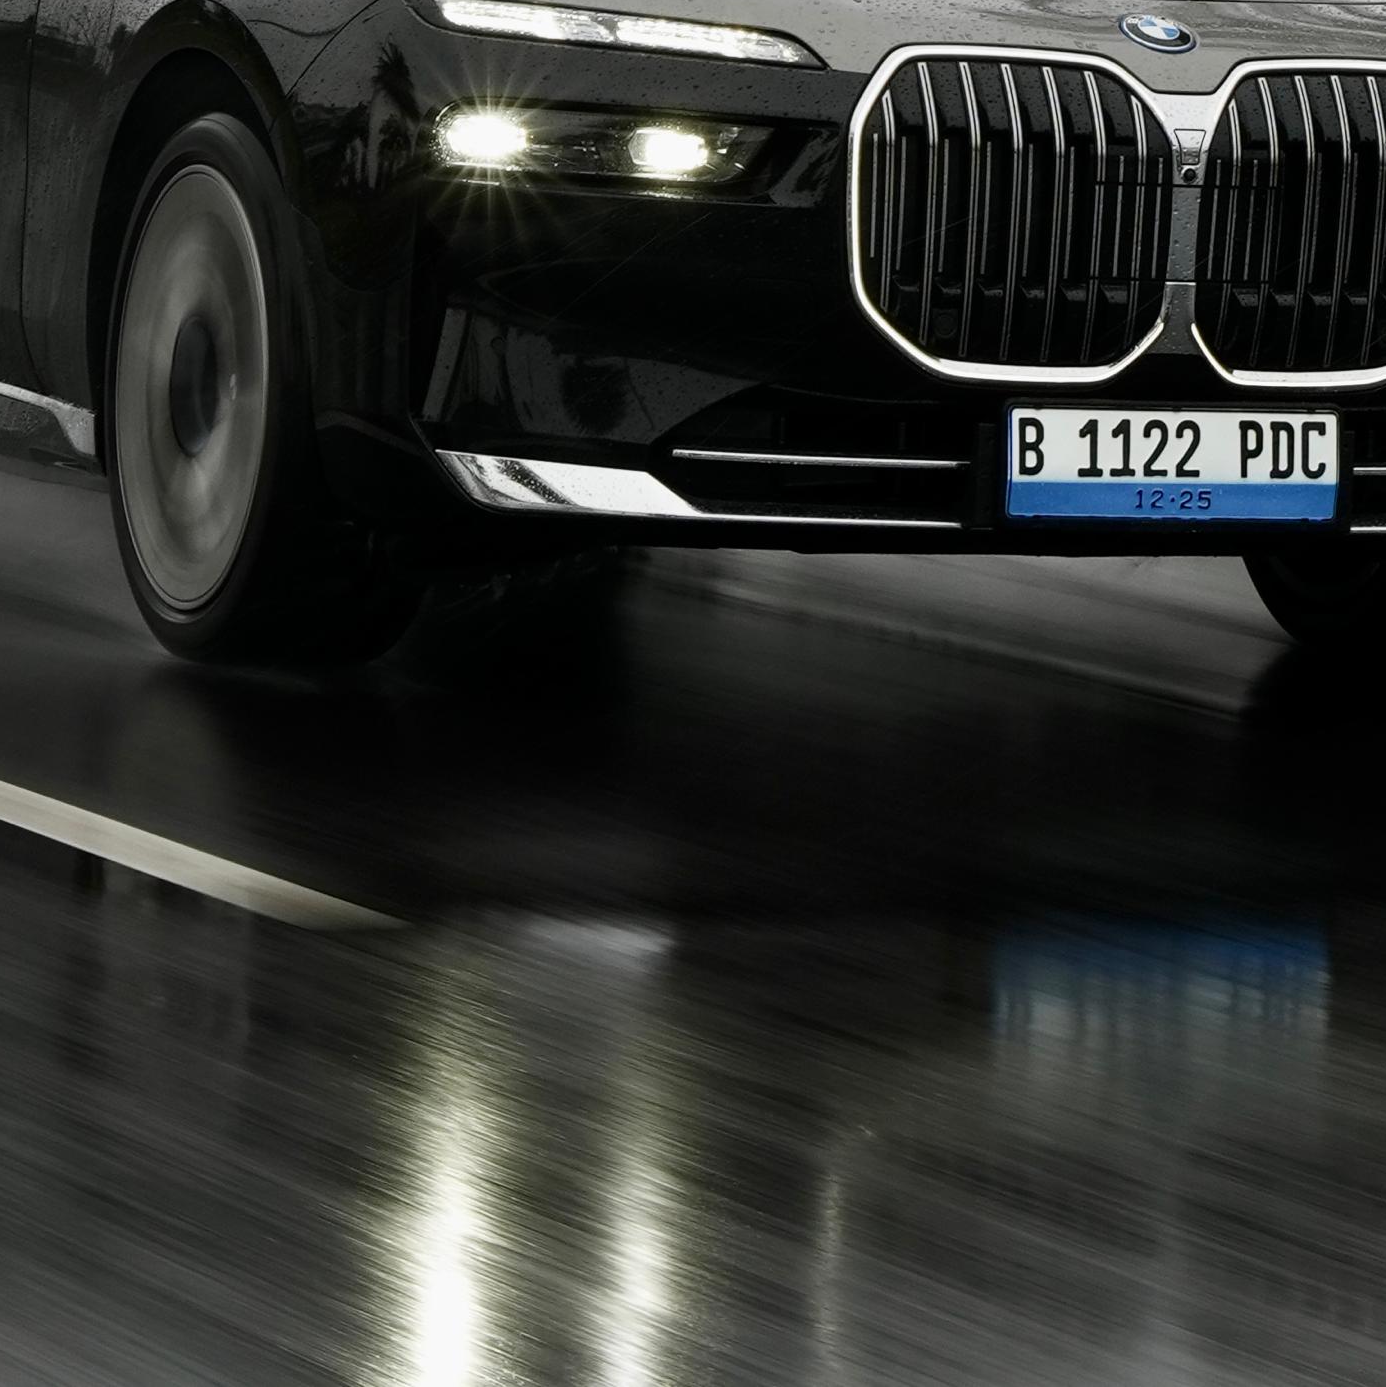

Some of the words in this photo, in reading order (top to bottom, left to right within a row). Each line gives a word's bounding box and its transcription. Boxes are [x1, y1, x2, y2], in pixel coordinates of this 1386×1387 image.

[1018, 417, 1045, 477] B
[1077, 418, 1201, 478] 1122
[1238, 420, 1327, 479] PDC
